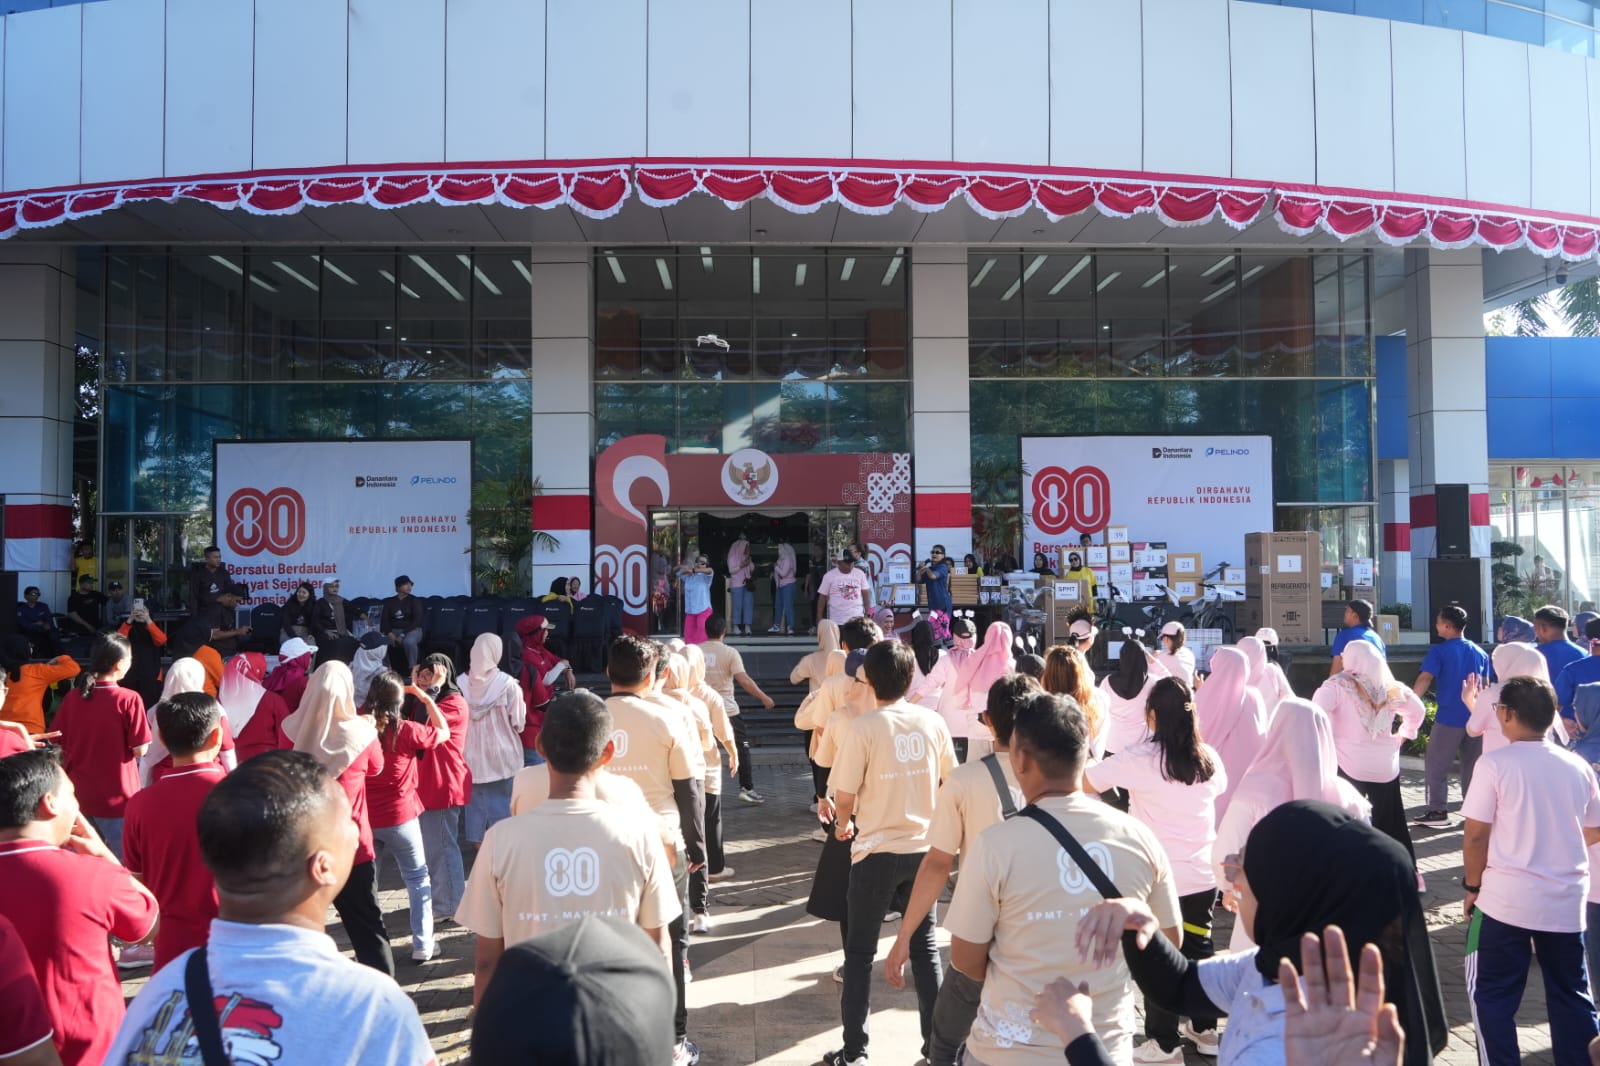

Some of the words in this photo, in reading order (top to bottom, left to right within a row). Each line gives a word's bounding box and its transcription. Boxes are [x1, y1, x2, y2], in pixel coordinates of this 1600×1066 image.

[1196, 486, 1251, 494] DIRGAHAYU
[1032, 466, 1111, 534] 80
[1147, 496, 1196, 504] REPUBLIK
[1200, 496, 1252, 504] INDONESIA
[226, 486, 306, 556] 80
[400, 516, 457, 524] DIRGAHAYU
[348, 526, 398, 534] REPUBLIK
[403, 525, 457, 533] INDONESIA
[228, 564, 274, 575] Bersatu
[278, 562, 336, 574] Berdaulat
[895, 731, 925, 762] 80
[544, 847, 600, 897] 80
[518, 912, 548, 921] SPMT
[1026, 910, 1063, 921] SPMT
